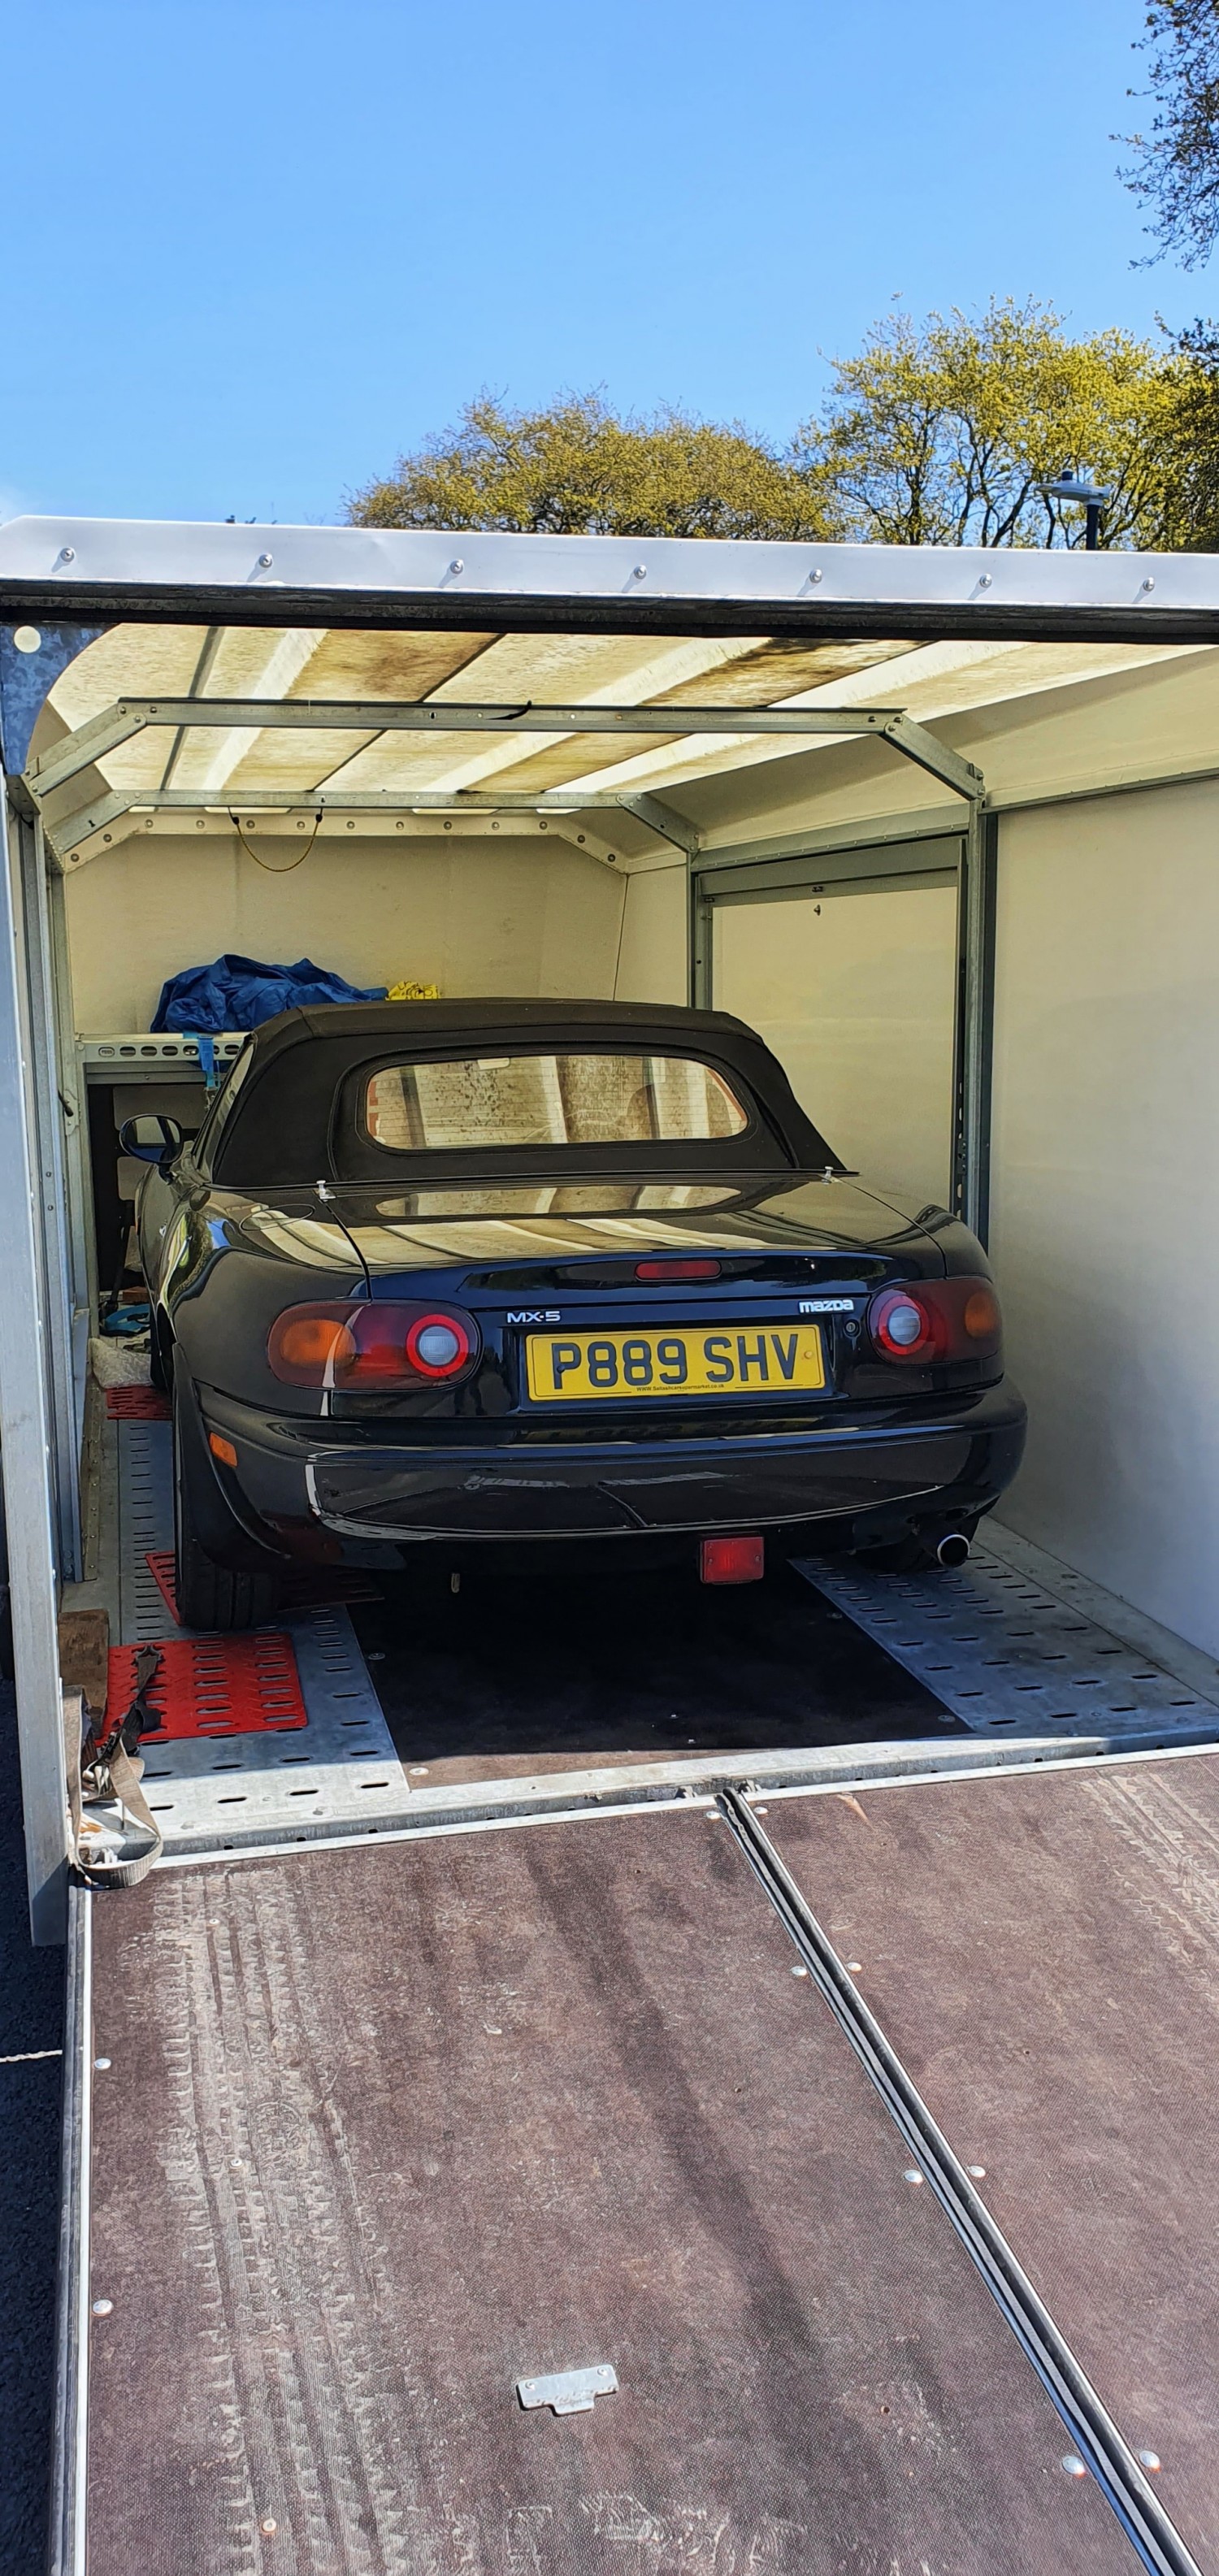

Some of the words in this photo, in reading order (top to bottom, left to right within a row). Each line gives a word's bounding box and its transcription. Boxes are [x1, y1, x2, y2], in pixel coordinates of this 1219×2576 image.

[799, 1298, 855, 1313] mazda
[506, 1310, 562, 1325] MX-5
[550, 1338, 688, 1390] P889
[703, 1334, 800, 1382] SHV
